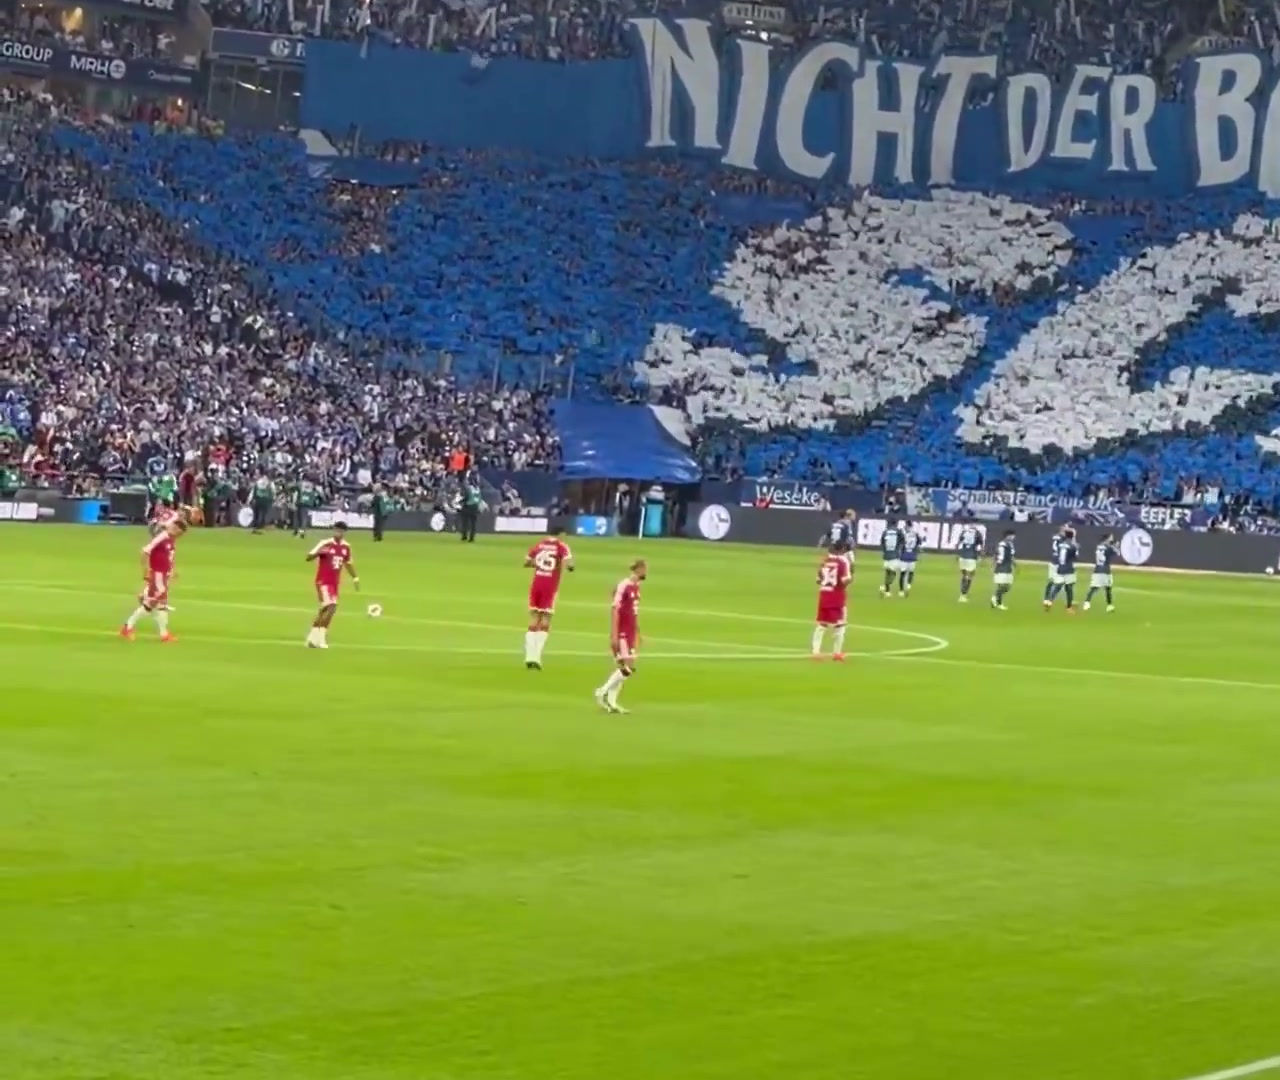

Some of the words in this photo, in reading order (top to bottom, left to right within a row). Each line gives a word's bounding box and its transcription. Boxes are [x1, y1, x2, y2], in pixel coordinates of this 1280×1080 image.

[2, 41, 53, 62] GROUP
[630, 17, 998, 184] NICHT
[1005, 64, 1157, 173] DER
